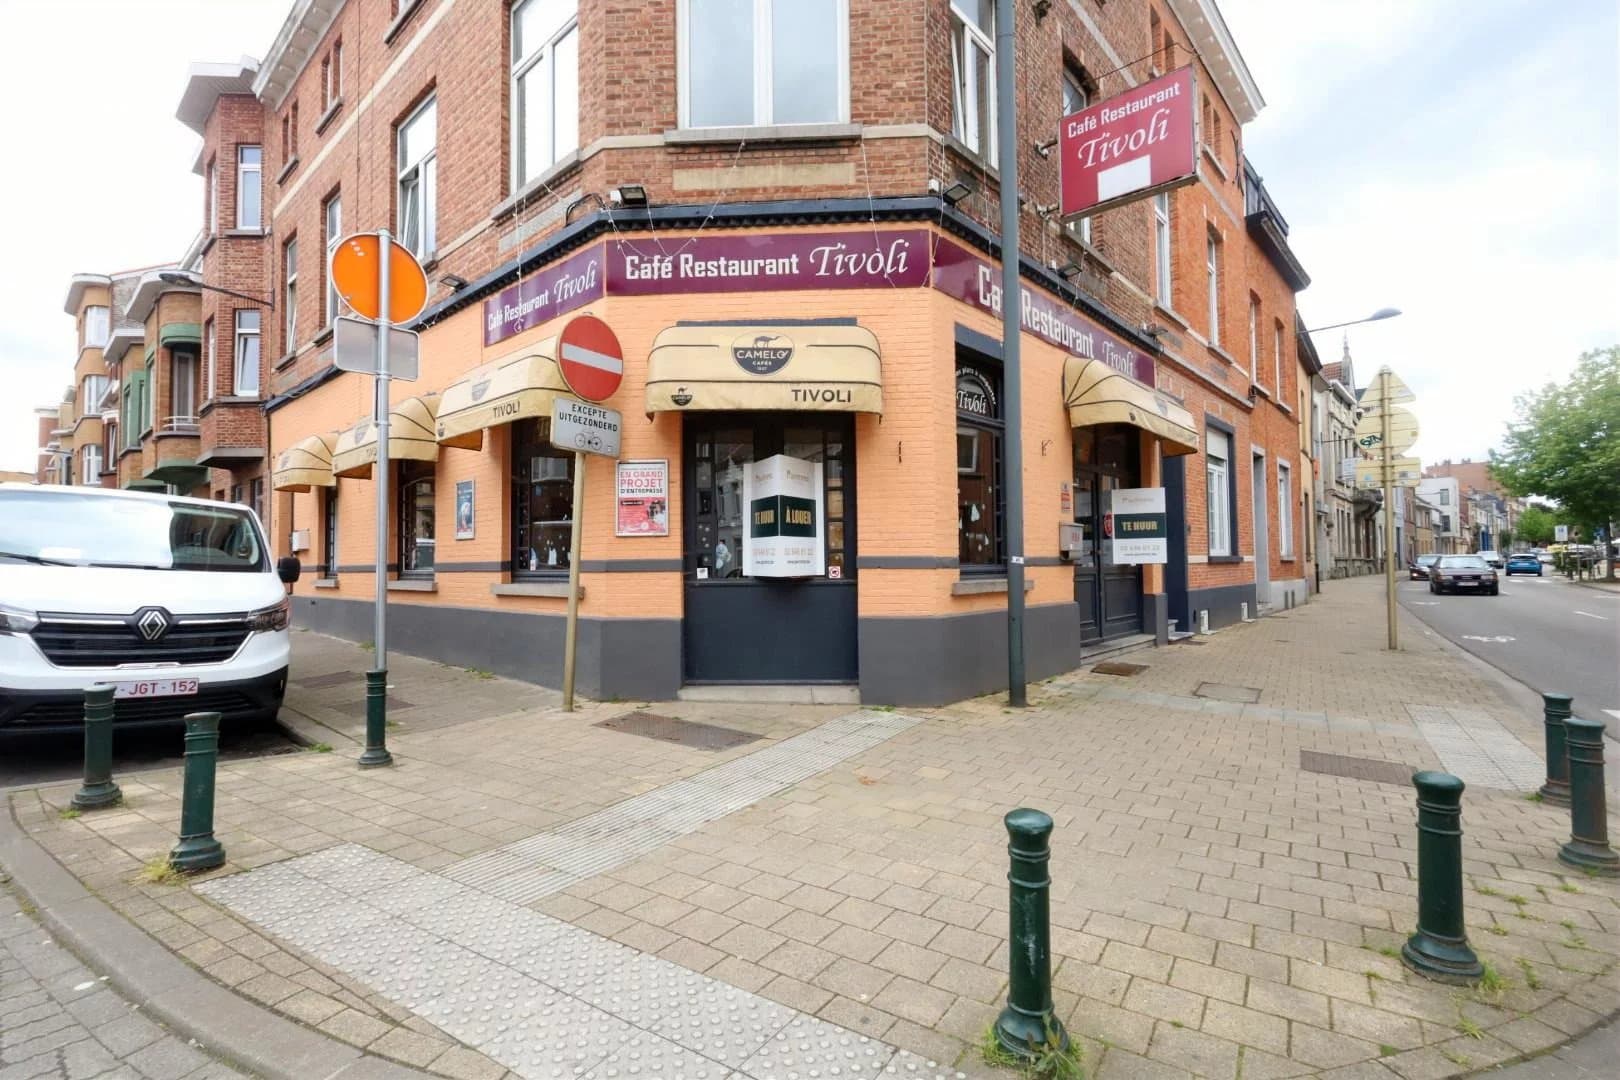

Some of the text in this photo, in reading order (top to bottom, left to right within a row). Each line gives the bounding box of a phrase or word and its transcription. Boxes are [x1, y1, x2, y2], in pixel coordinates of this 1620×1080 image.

[1068, 82, 1180, 138] Café Restaurant
[1078, 108, 1170, 168] Tivoli
[626, 239, 909, 280] Café Restaurant Tivoli
[488, 260, 598, 331] Café Restaurant Tivoli
[978, 264, 1135, 377] Ca Restaurant Tivoli
[736, 350, 789, 360] CAMELO
[791, 389, 851, 403] TIVOLI
[956, 390, 987, 414] Tivoli
[493, 400, 521, 419] TIVOLI
[572, 403, 607, 419] EXCEPTE
[560, 412, 618, 432] UITGEZONDERD
[620, 478, 663, 488] PROJET
